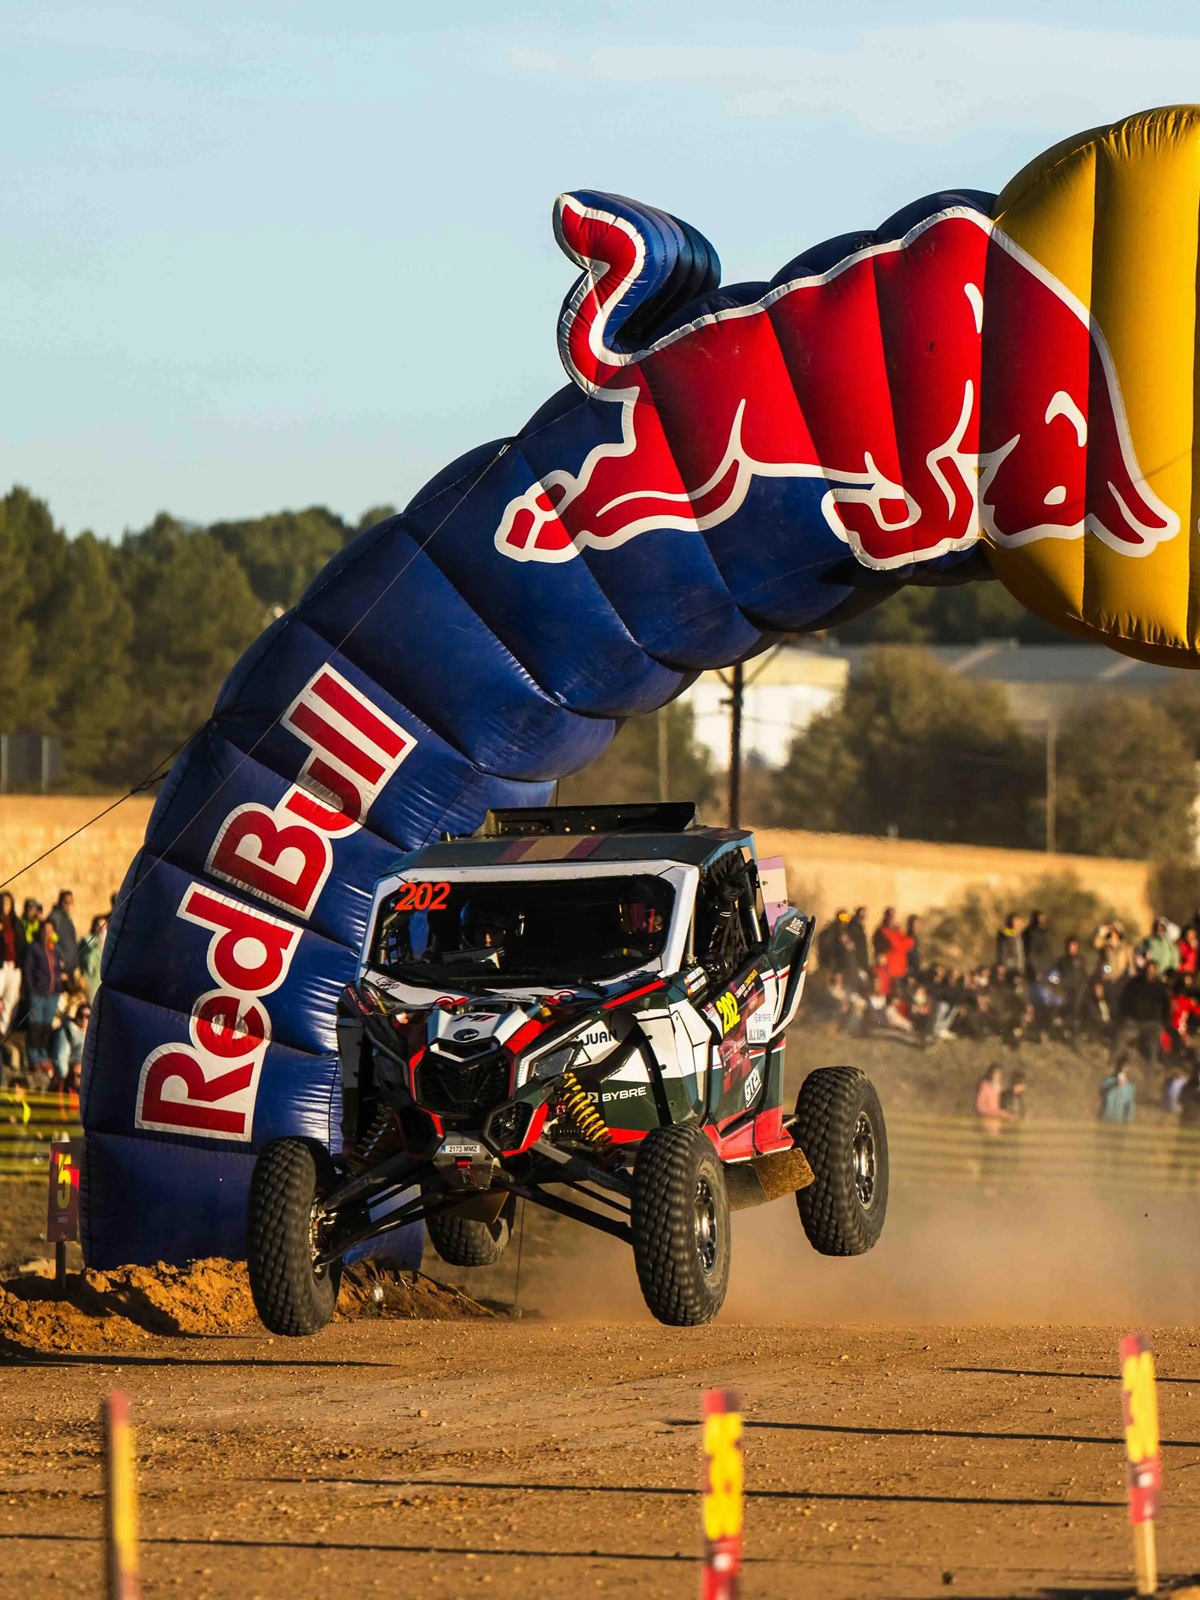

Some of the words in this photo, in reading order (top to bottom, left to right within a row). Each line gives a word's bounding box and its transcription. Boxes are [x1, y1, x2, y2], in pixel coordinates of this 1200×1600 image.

[207, 667, 413, 916] Bull
[394, 882, 451, 911] 202
[138, 886, 299, 1138] Red
[716, 992, 740, 1034] 202
[602, 1086, 647, 1102] BYBRE
[57, 1154, 72, 1209] 5
